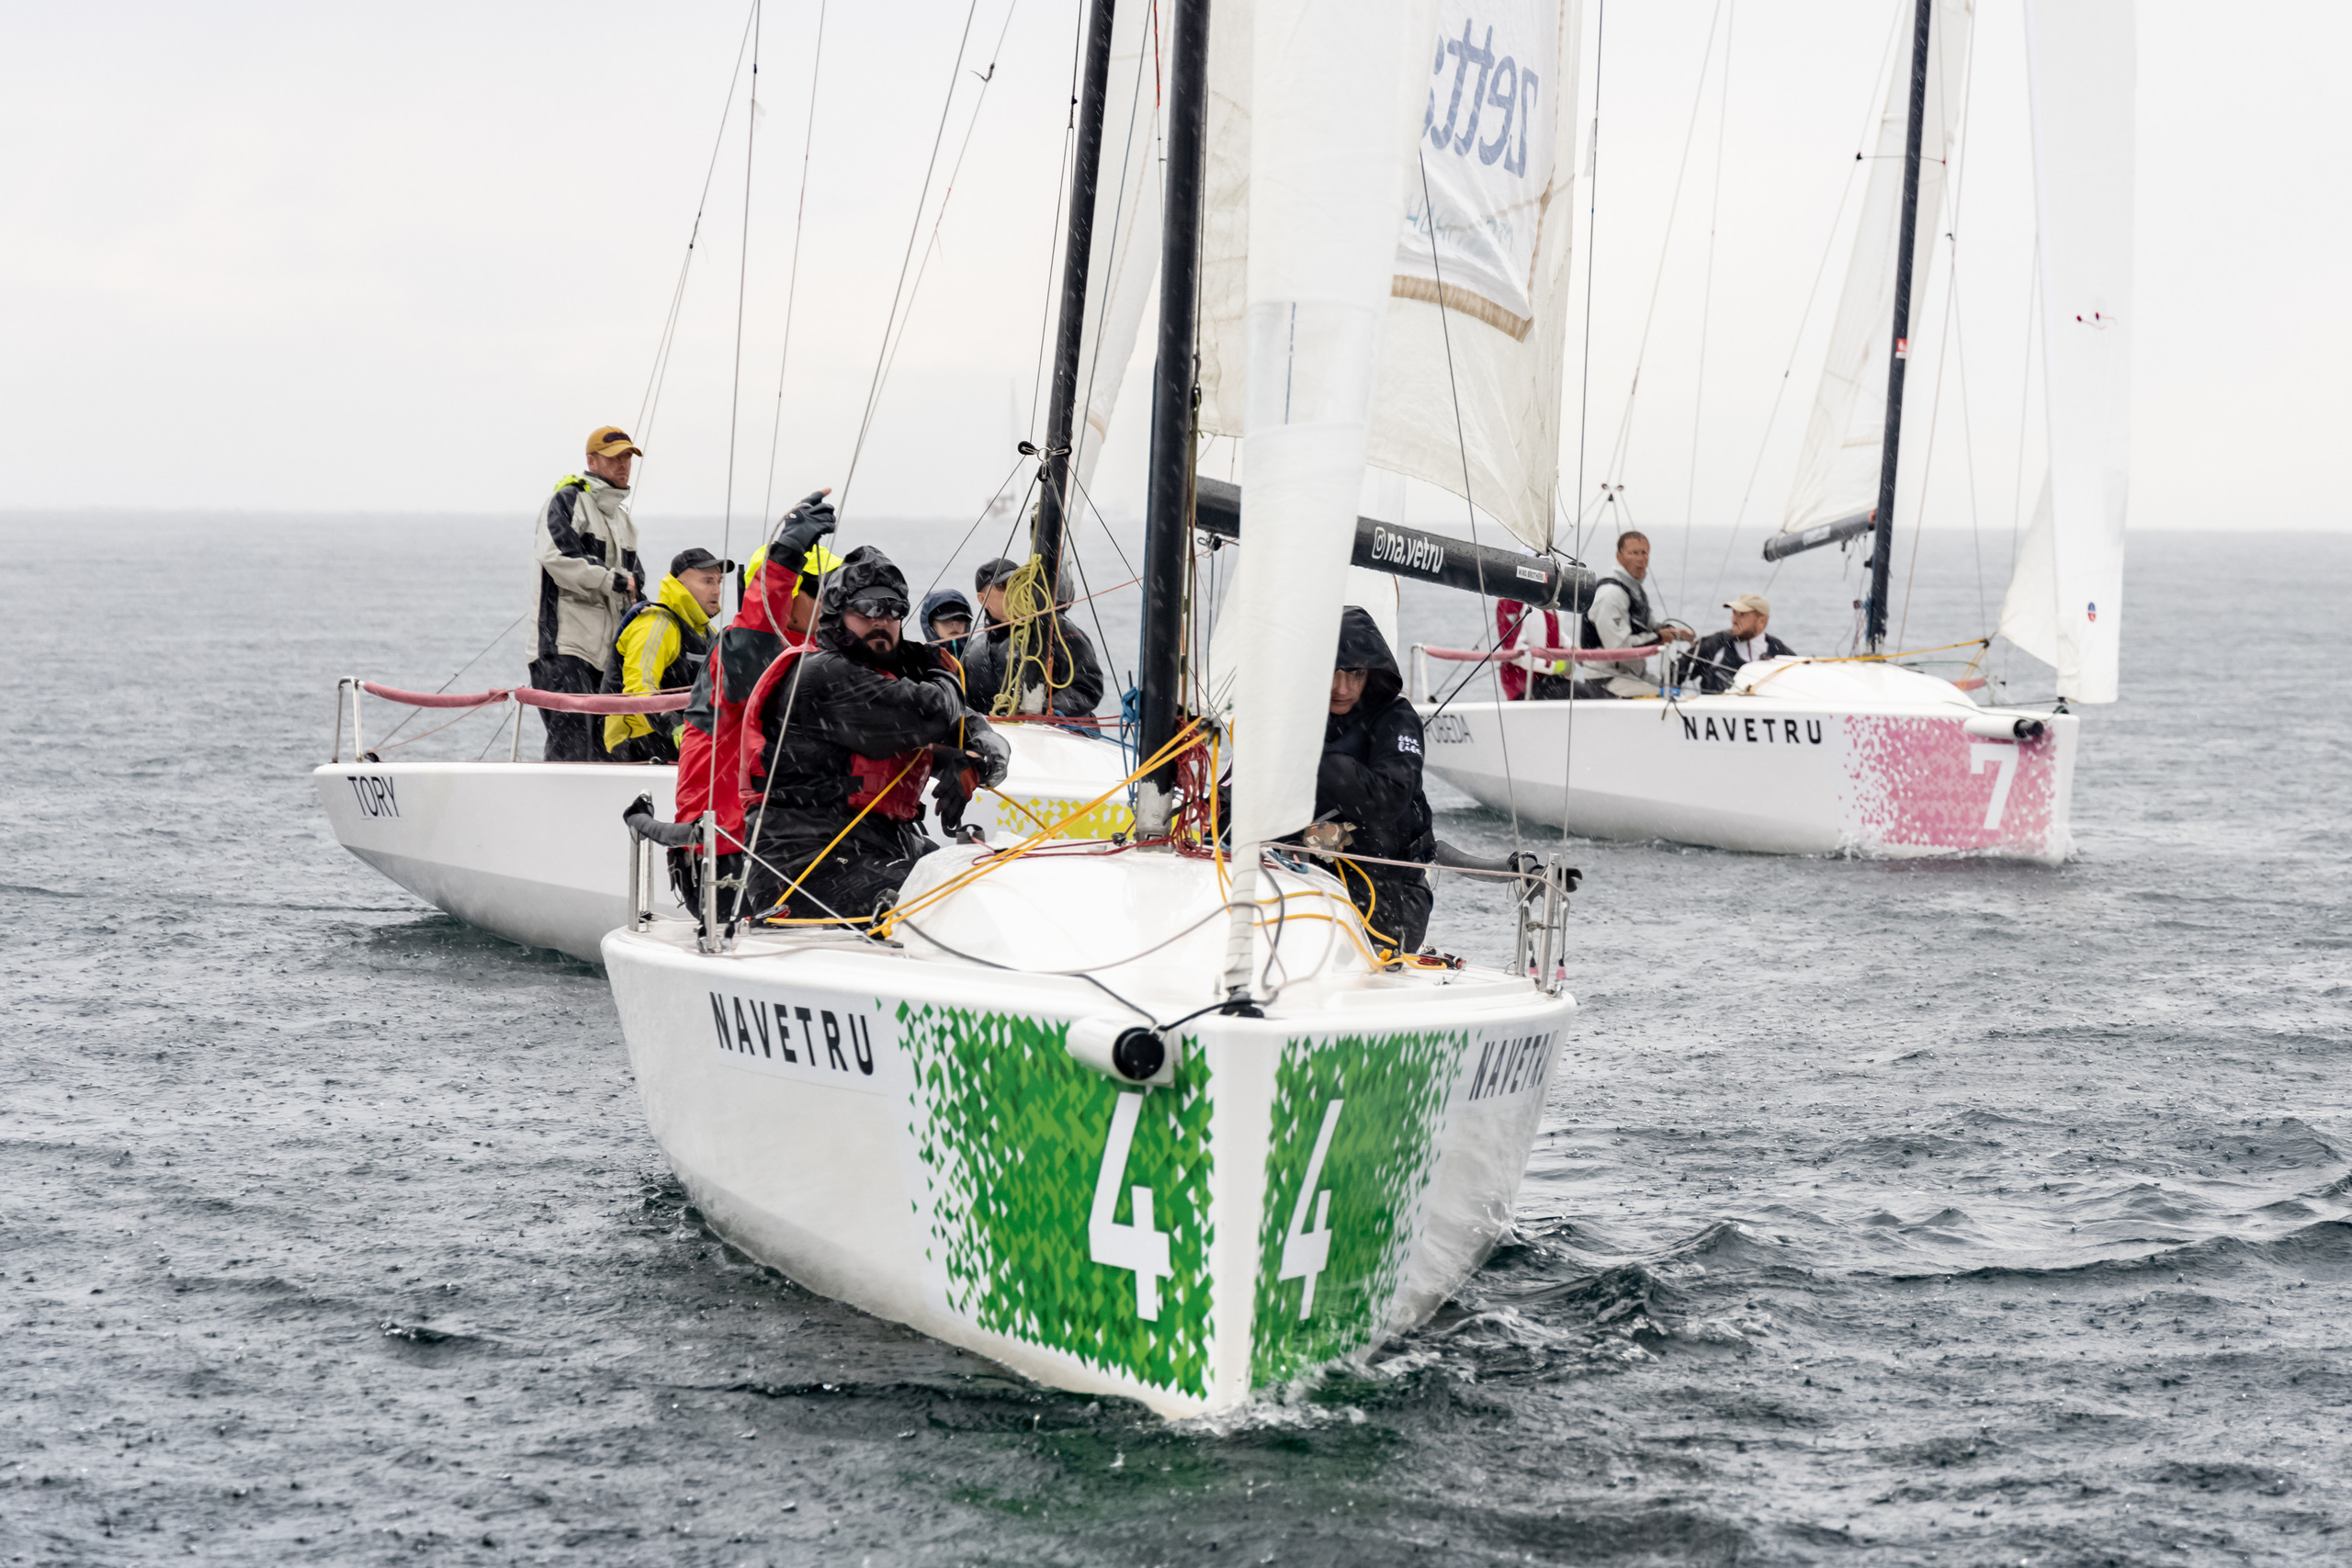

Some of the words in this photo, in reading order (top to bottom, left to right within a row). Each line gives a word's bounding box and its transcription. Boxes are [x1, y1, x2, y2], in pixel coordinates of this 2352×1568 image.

[1682, 716, 1822, 745] NAVETRU
[346, 775, 400, 818] TORY
[1970, 742, 2019, 830] 7
[709, 991, 874, 1076] NAVETRU
[1088, 1091, 1173, 1323] 4
[1278, 1099, 1345, 1322] 4
